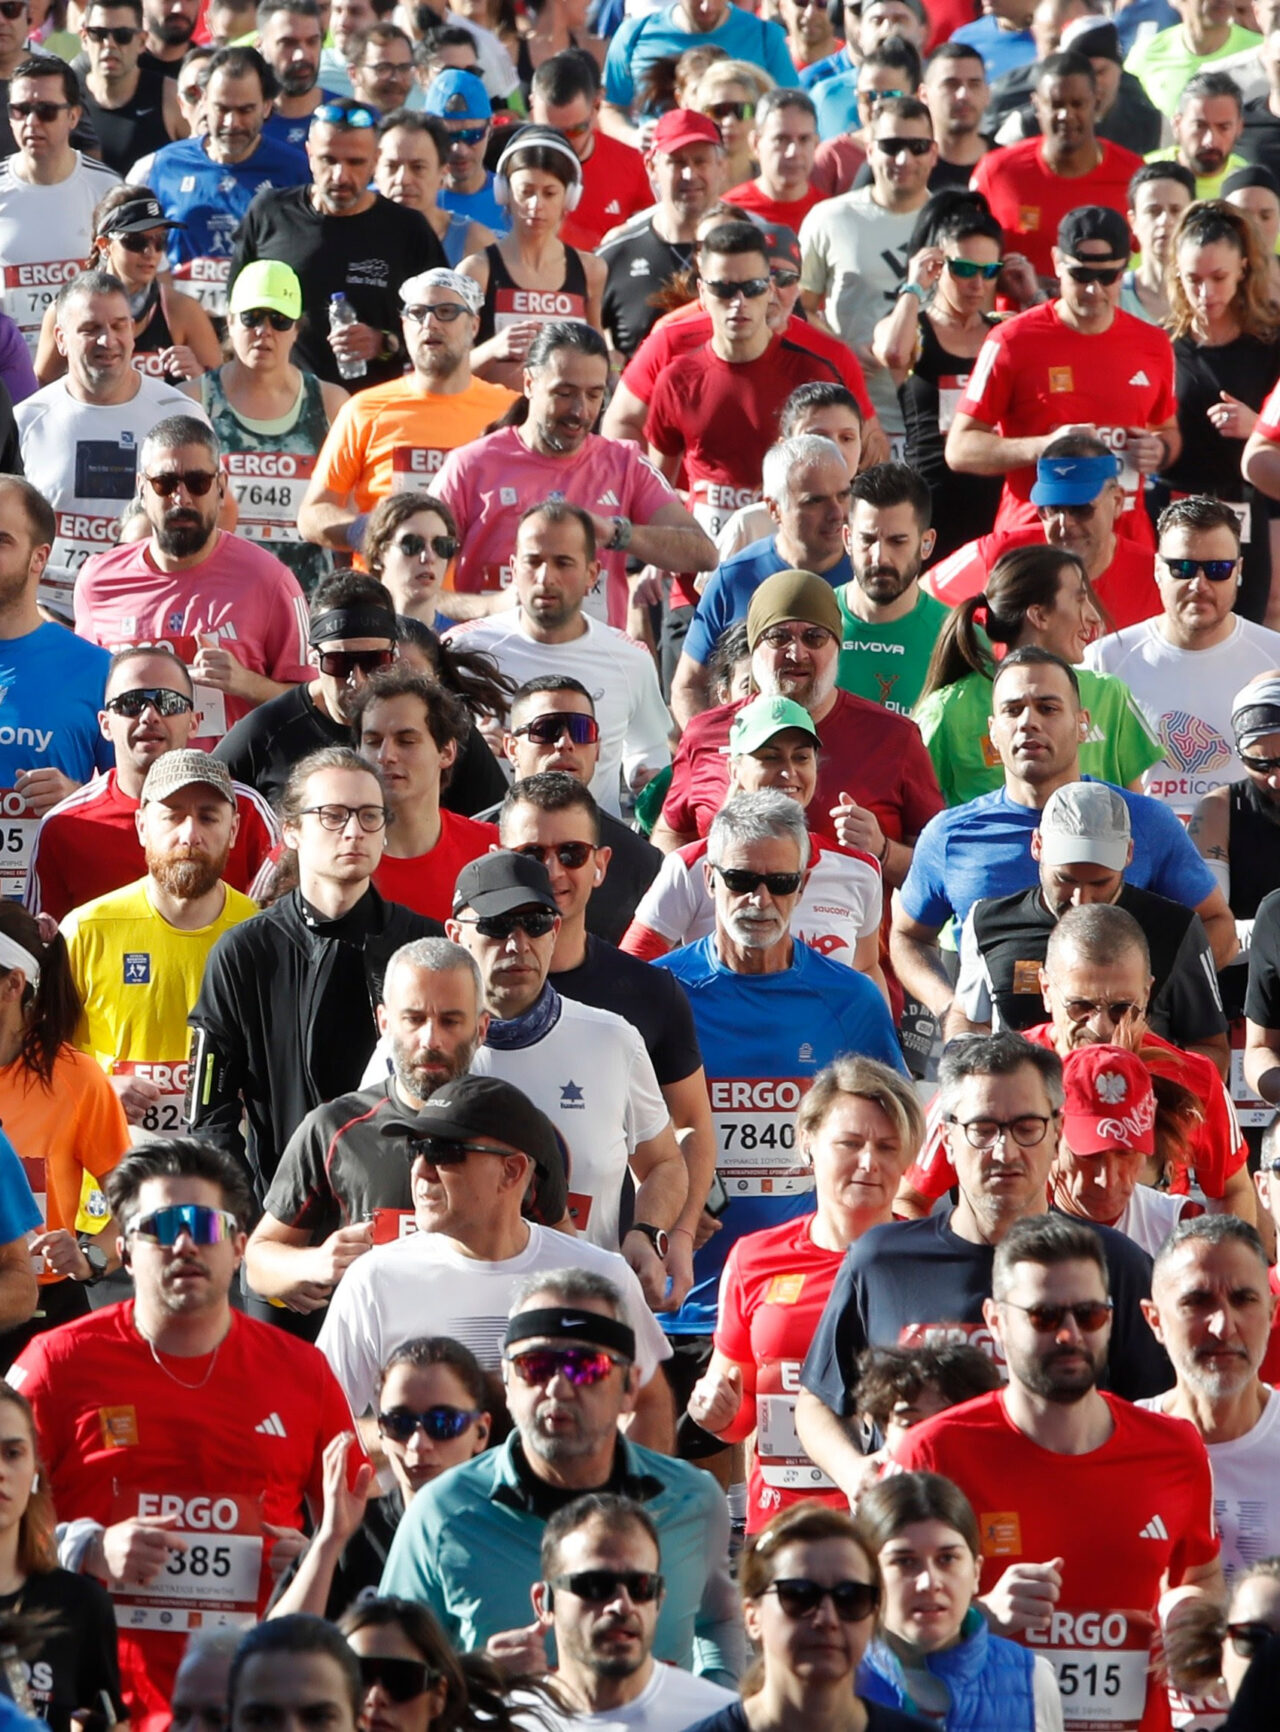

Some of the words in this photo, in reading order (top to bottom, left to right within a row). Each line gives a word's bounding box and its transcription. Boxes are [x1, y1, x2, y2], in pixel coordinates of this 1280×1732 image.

[19, 262, 81, 286] ERGO
[190, 258, 231, 280] ERG
[28, 292, 59, 313] 79
[513, 292, 572, 314] ERGO
[131, 355, 164, 375] GO
[1097, 427, 1126, 449] GO
[229, 454, 296, 477] ERGO
[411, 449, 445, 472] ER
[235, 485, 291, 506] 7648
[842, 640, 905, 655] GIVOVA
[813, 905, 851, 917] saucony
[134, 1064, 189, 1091] ERG
[712, 1081, 800, 1109] ERGO
[142, 1105, 185, 1131] 82
[720, 1123, 795, 1150] 7840
[138, 1493, 239, 1531] ERGO
[166, 1546, 231, 1577] 385
[1060, 1663, 1120, 1696] 515
